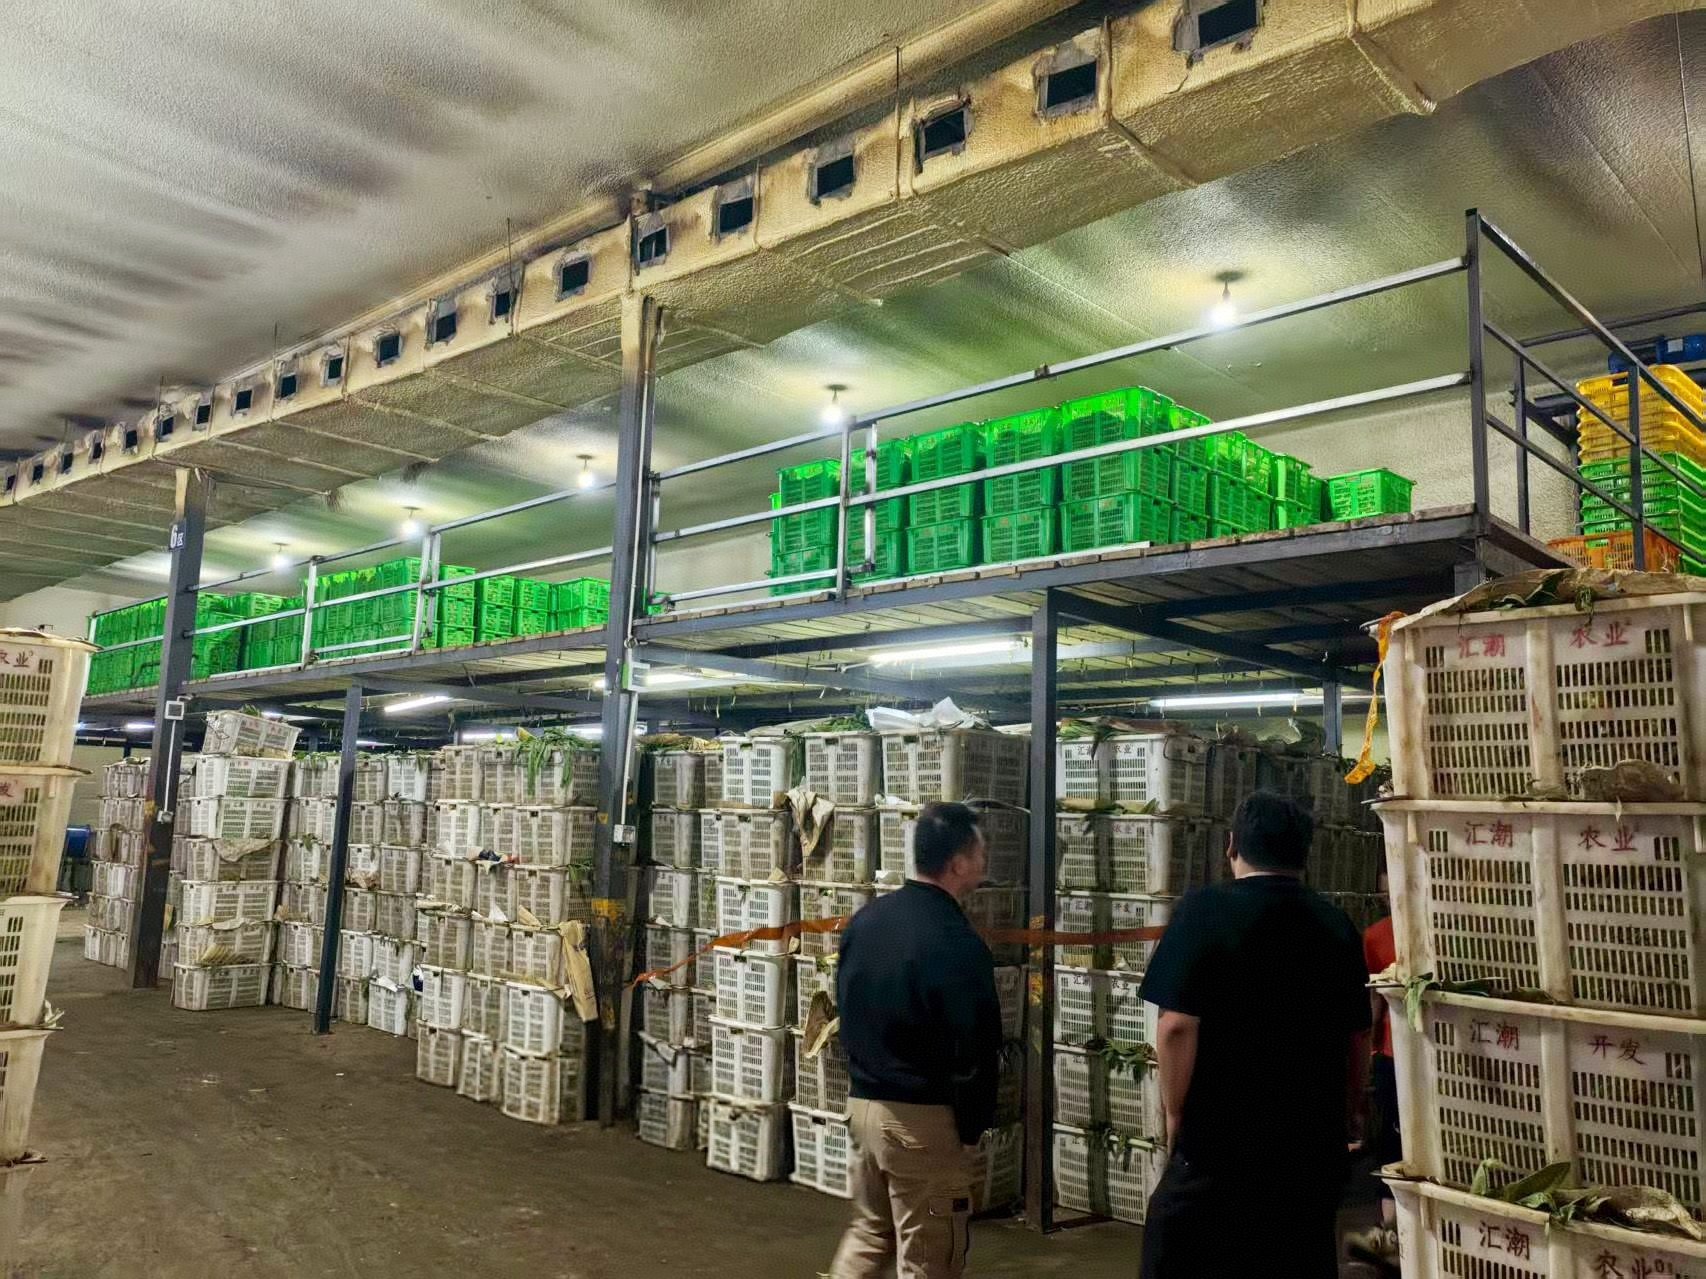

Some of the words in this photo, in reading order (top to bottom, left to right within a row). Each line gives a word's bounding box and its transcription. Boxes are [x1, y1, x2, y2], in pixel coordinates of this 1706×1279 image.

[1458, 634, 1506, 658] 汇潮
[1568, 621, 1629, 648] 农业
[1465, 820, 1514, 848] 汇潮
[1578, 823, 1638, 851] 农业
[1470, 1018, 1519, 1051] 汇潮
[1588, 1034, 1647, 1065] 开发
[1479, 1221, 1530, 1261] 汇潮
